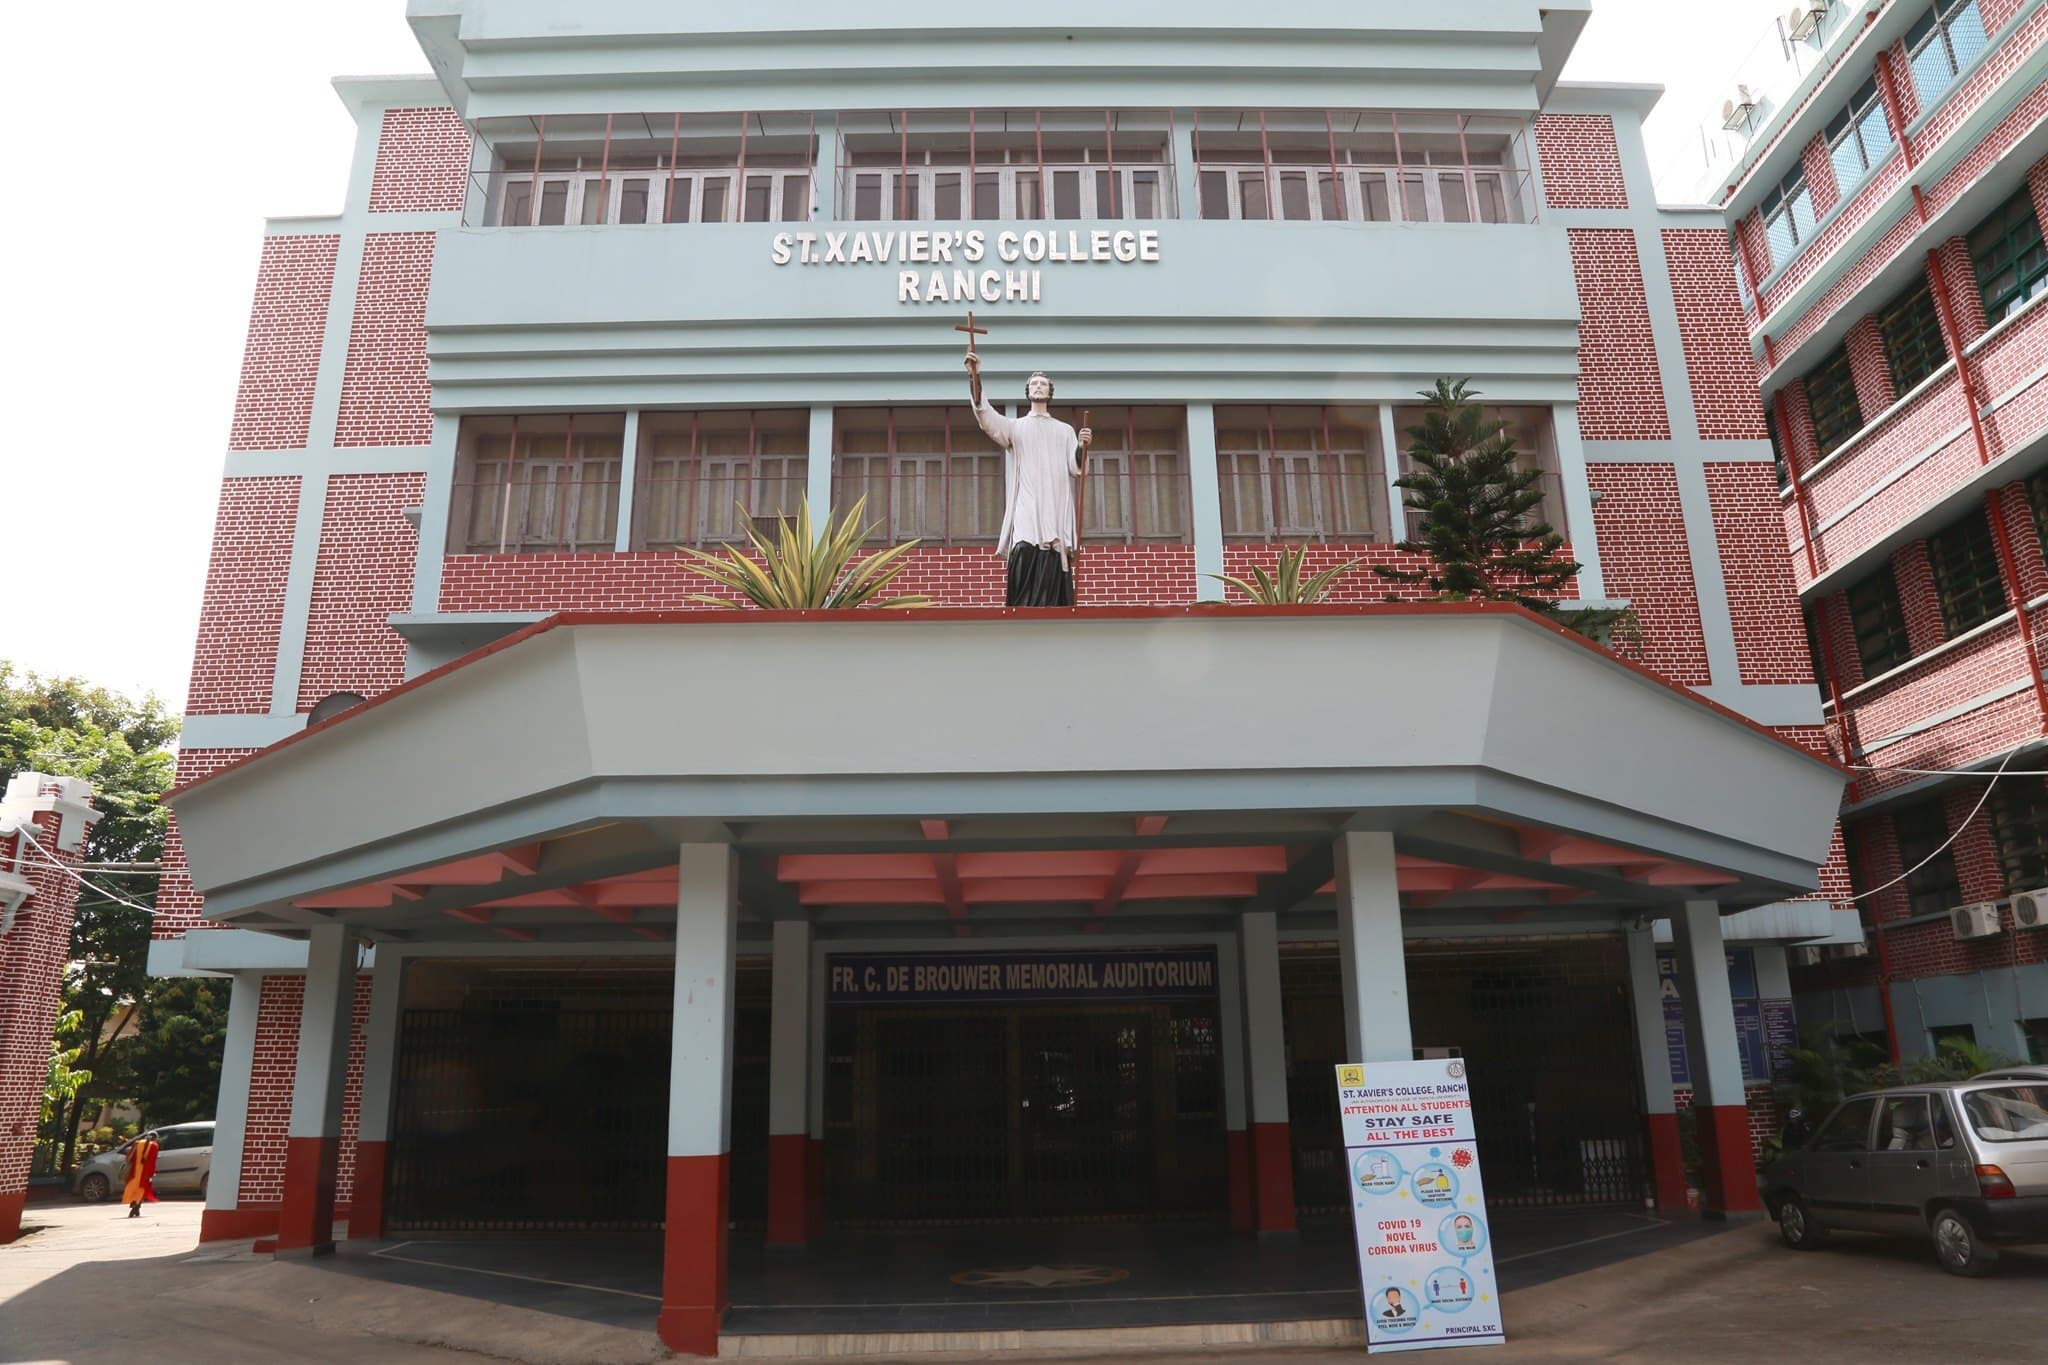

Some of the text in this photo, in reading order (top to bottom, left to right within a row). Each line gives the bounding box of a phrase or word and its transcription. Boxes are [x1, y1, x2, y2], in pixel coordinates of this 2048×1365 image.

[997, 229, 1160, 263] COLLEGE
[899, 268, 1041, 303] RANCHI
[832, 960, 1213, 993] FR. C. DE BROUWER MEMORIAL AUDITORIUM
[1343, 1089, 1356, 1099] ST.
[1358, 1087, 1394, 1098] XAVIER'S
[1395, 1085, 1435, 1096] COLLEGE,
[1436, 1084, 1467, 1093] RANCHI
[1343, 1103, 1398, 1115] ATTENTION
[1401, 1102, 1418, 1112] ALL
[1421, 1099, 1471, 1110] STUDENTS
[1365, 1114, 1454, 1128] STAY SAFE
[1367, 1127, 1455, 1141] ALL THE BEST
[1378, 1218, 1422, 1230] COVID 19
[1386, 1231, 1416, 1242] NOVEL
[1368, 1242, 1438, 1256] CORONA VIRUS
[1445, 1324, 1496, 1334] PRINCIPAL SXC
